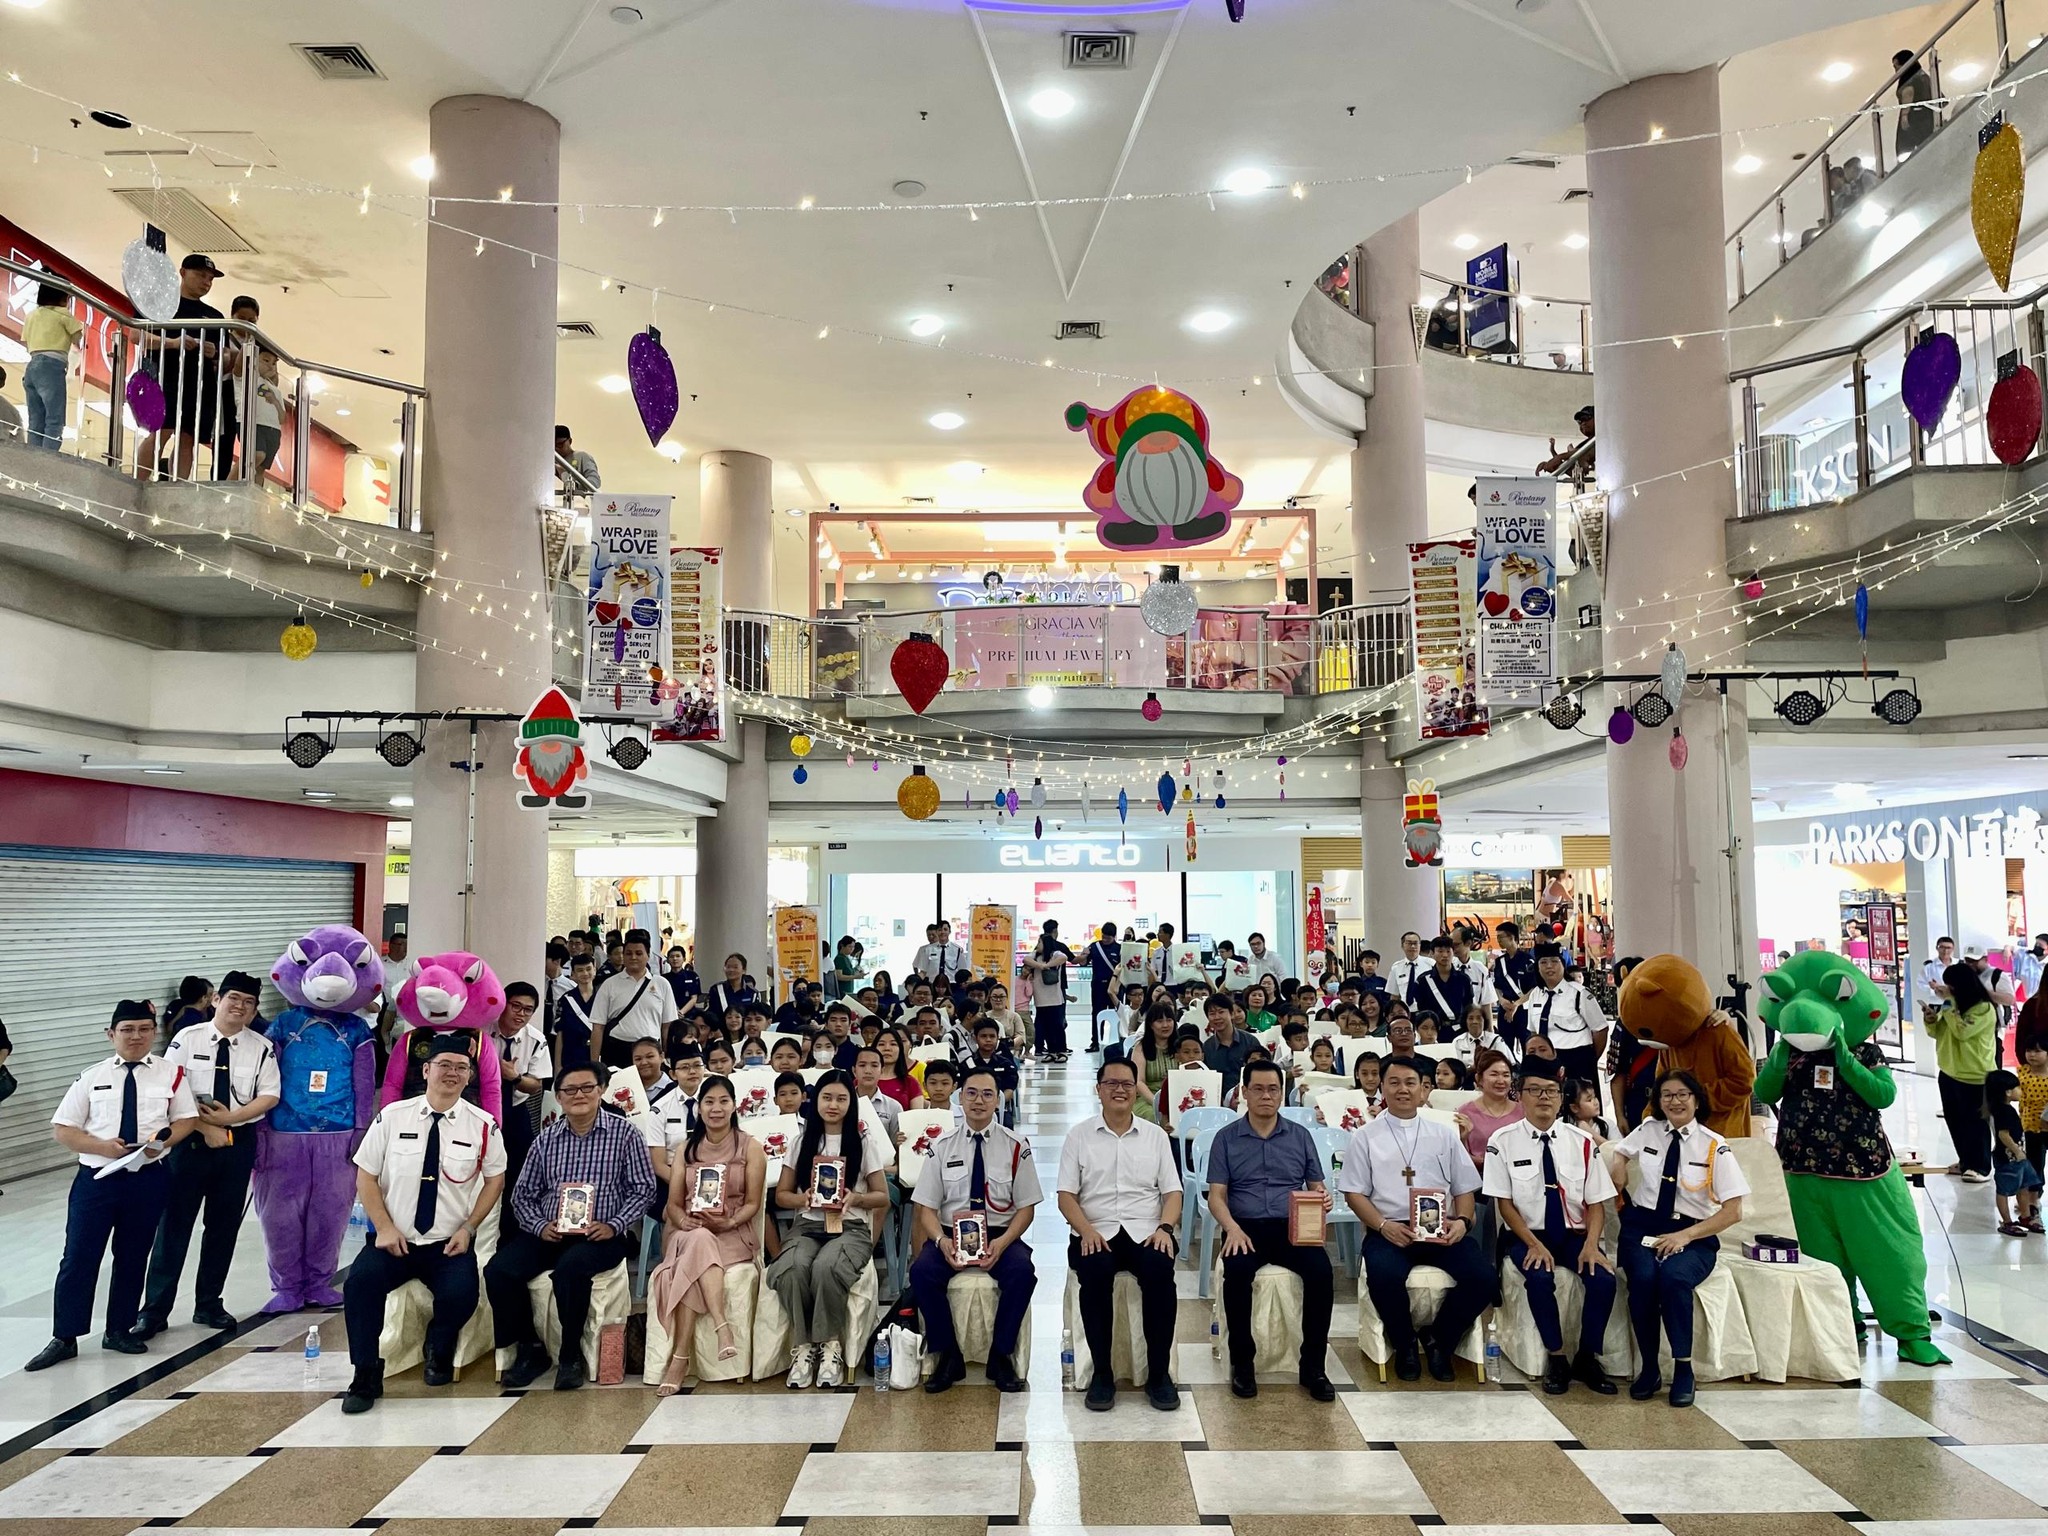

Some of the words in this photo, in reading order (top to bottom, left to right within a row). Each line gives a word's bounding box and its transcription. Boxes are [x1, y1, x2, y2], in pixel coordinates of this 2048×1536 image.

[624, 501, 662, 517] Bintang
[1485, 517, 1528, 528] WRAP
[600, 526, 642, 538] WRAP
[1495, 528, 1546, 544] LOVE
[609, 538, 658, 555] LOVE
[1024, 616, 1085, 630] GRACIA
[634, 632, 652, 641] GIFT
[987, 649, 1056, 662] PREIUM
[1063, 649, 1134, 661] JEWERY
[1808, 815, 1971, 865] PARKSON
[1312, 903, 1321, 948] MERRY
